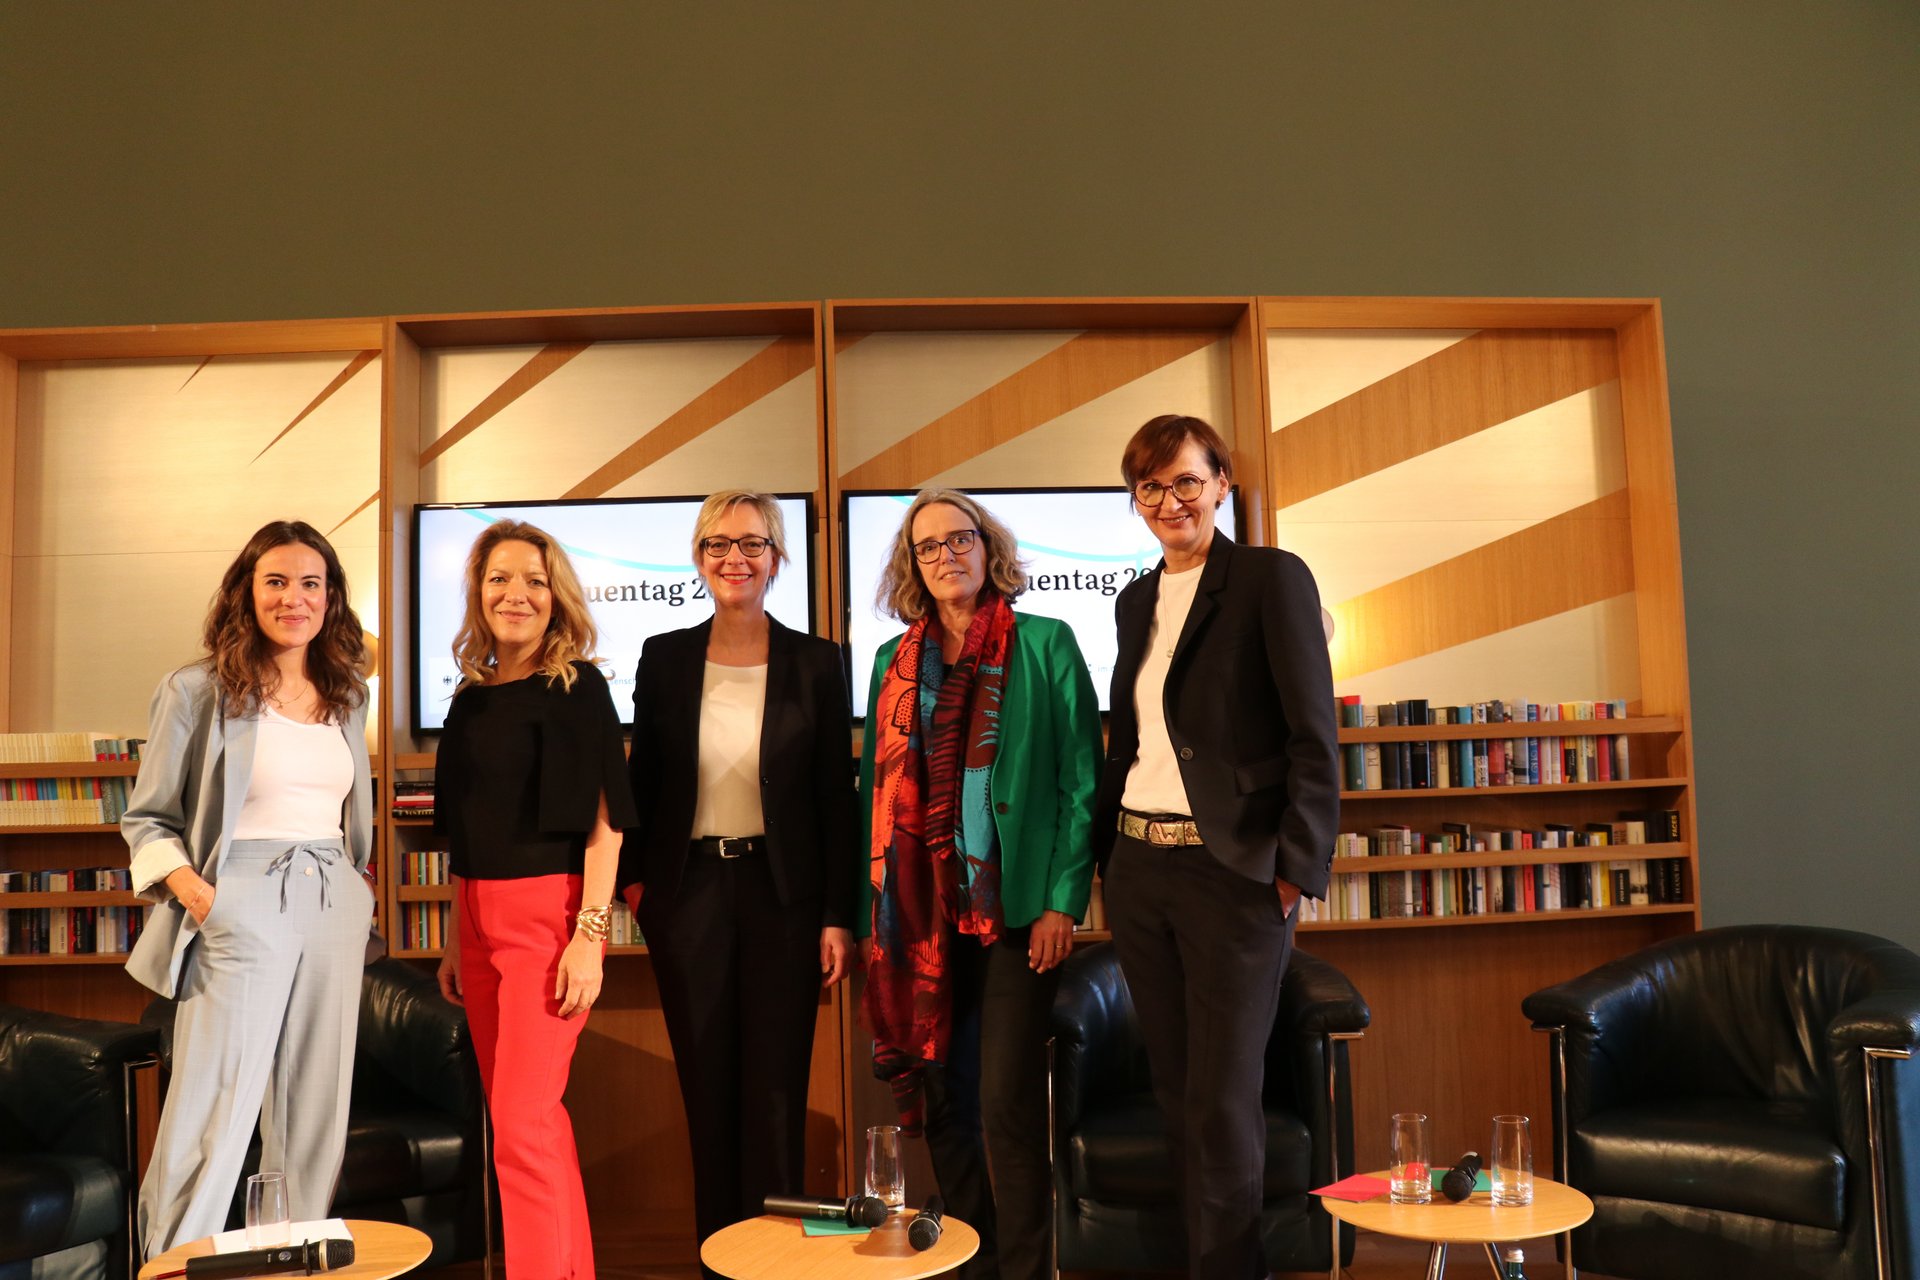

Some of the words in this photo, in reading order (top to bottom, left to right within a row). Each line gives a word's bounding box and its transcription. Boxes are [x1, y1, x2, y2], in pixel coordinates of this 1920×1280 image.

[585, 579, 686, 607] uentag
[691, 577, 706, 600] 2
[1027, 569, 1118, 597] uentag
